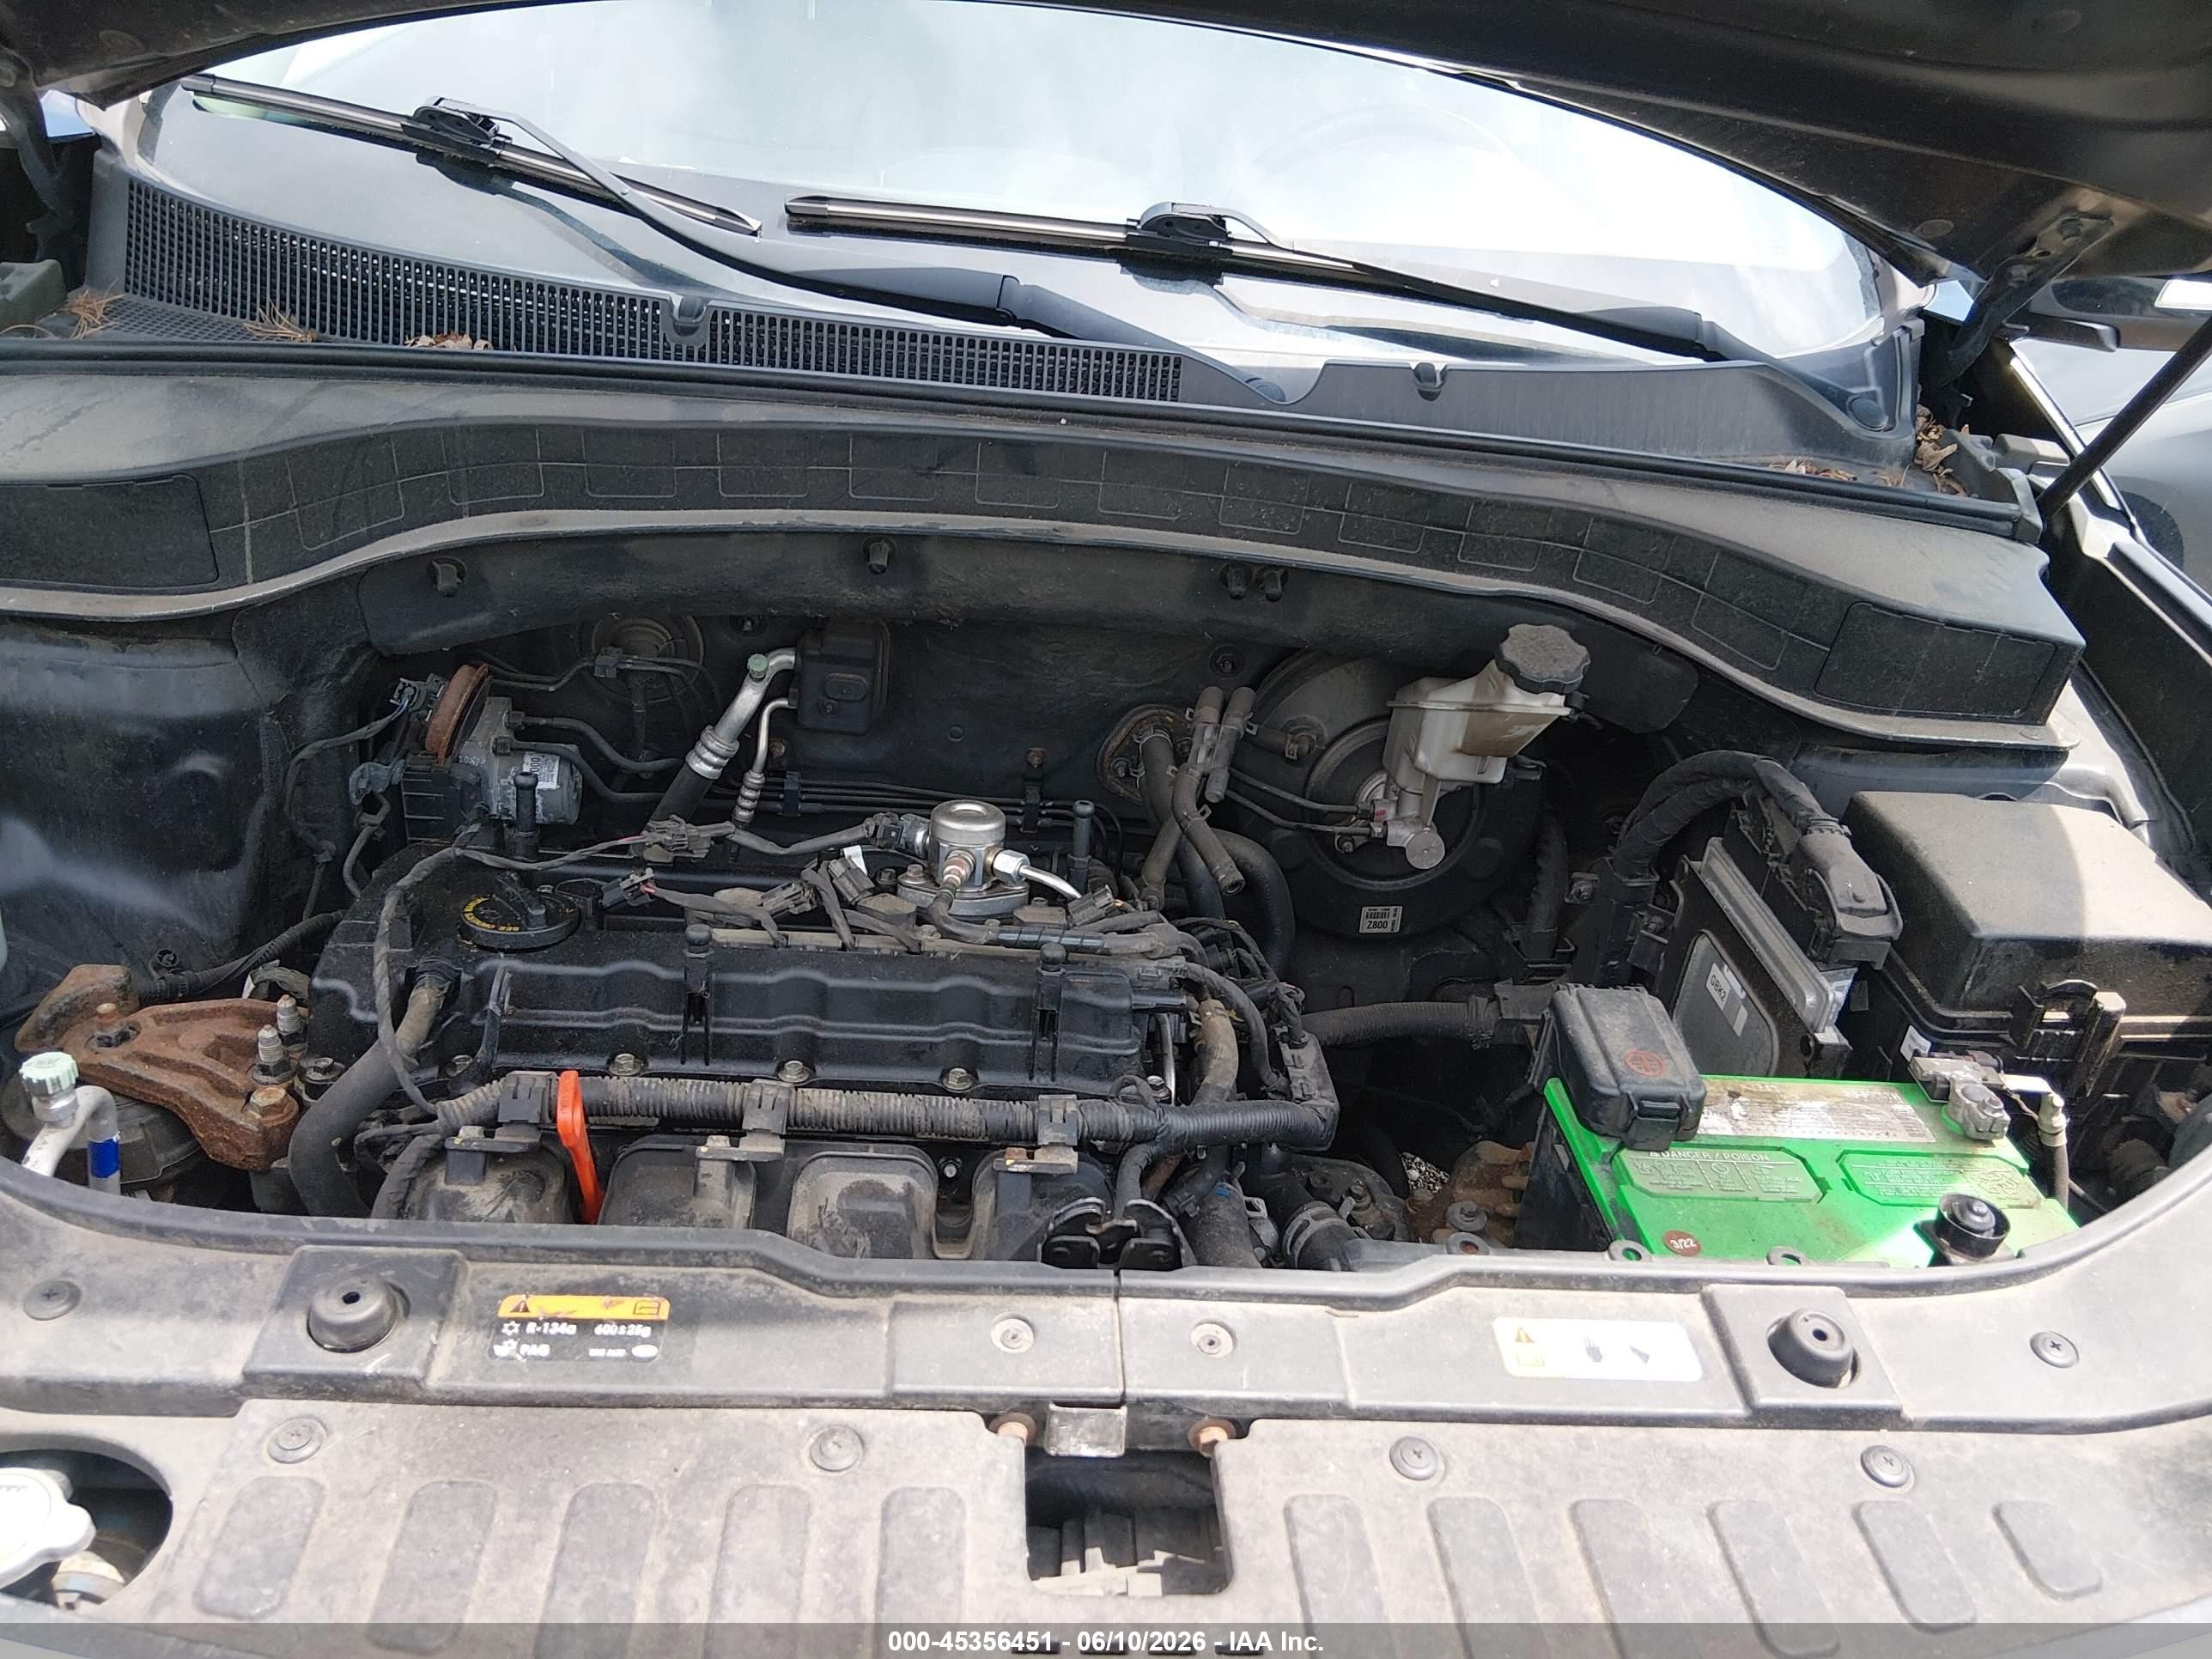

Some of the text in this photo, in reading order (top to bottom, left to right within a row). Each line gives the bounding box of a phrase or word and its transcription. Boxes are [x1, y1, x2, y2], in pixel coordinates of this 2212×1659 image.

[1366, 920, 1389, 929] Z800
[1710, 975, 1726, 1002] GBK2
[1723, 1152, 1771, 1161] POISON
[1669, 1237, 1697, 1250] 3/22
[526, 1322, 577, 1335] R-134a
